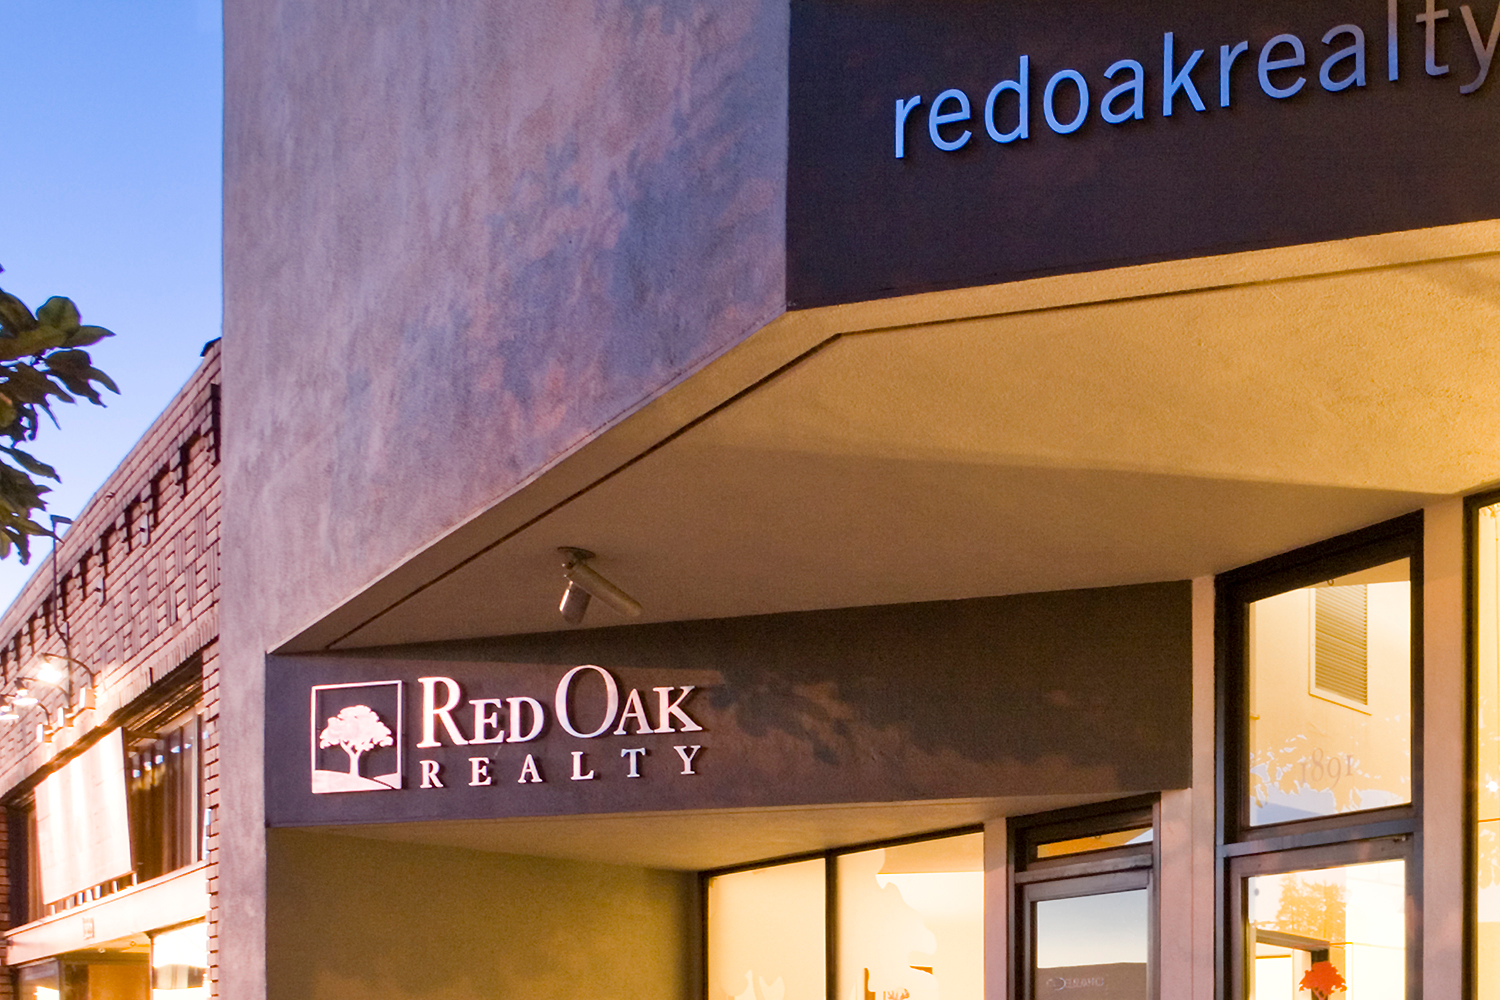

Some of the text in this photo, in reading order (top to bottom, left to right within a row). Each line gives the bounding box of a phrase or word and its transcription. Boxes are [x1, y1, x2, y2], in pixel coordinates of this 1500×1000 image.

[416, 664, 703, 749] RED OAK
[419, 744, 701, 789] REALTY
[1301, 748, 1354, 789] 1891
